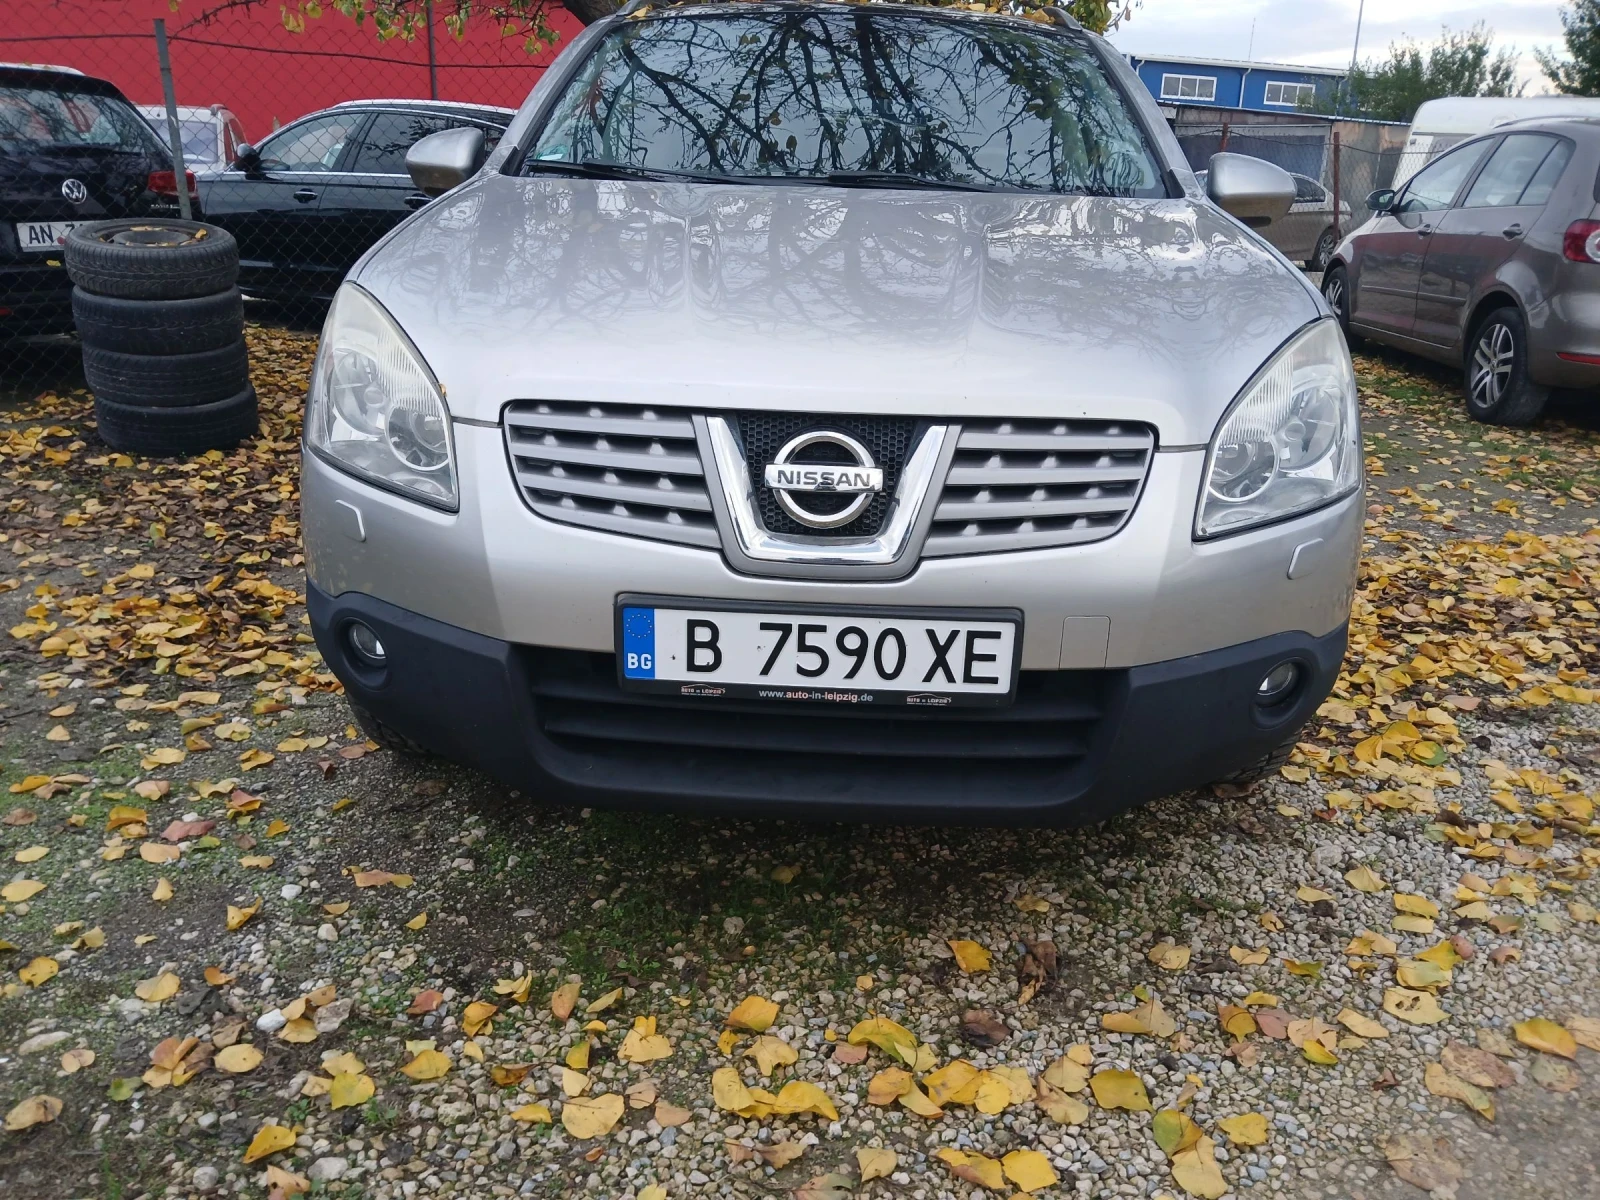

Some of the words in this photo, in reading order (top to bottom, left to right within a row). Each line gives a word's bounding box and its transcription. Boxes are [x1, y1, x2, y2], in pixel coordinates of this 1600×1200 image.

[28, 224, 54, 244] AN
[777, 469, 871, 487] NISSAN
[686, 618, 723, 673] B
[758, 621, 907, 681] 7590
[921, 628, 1002, 685] XE
[627, 652, 652, 670] BG
[758, 690, 874, 703] www.auto-in-leipzig.de
